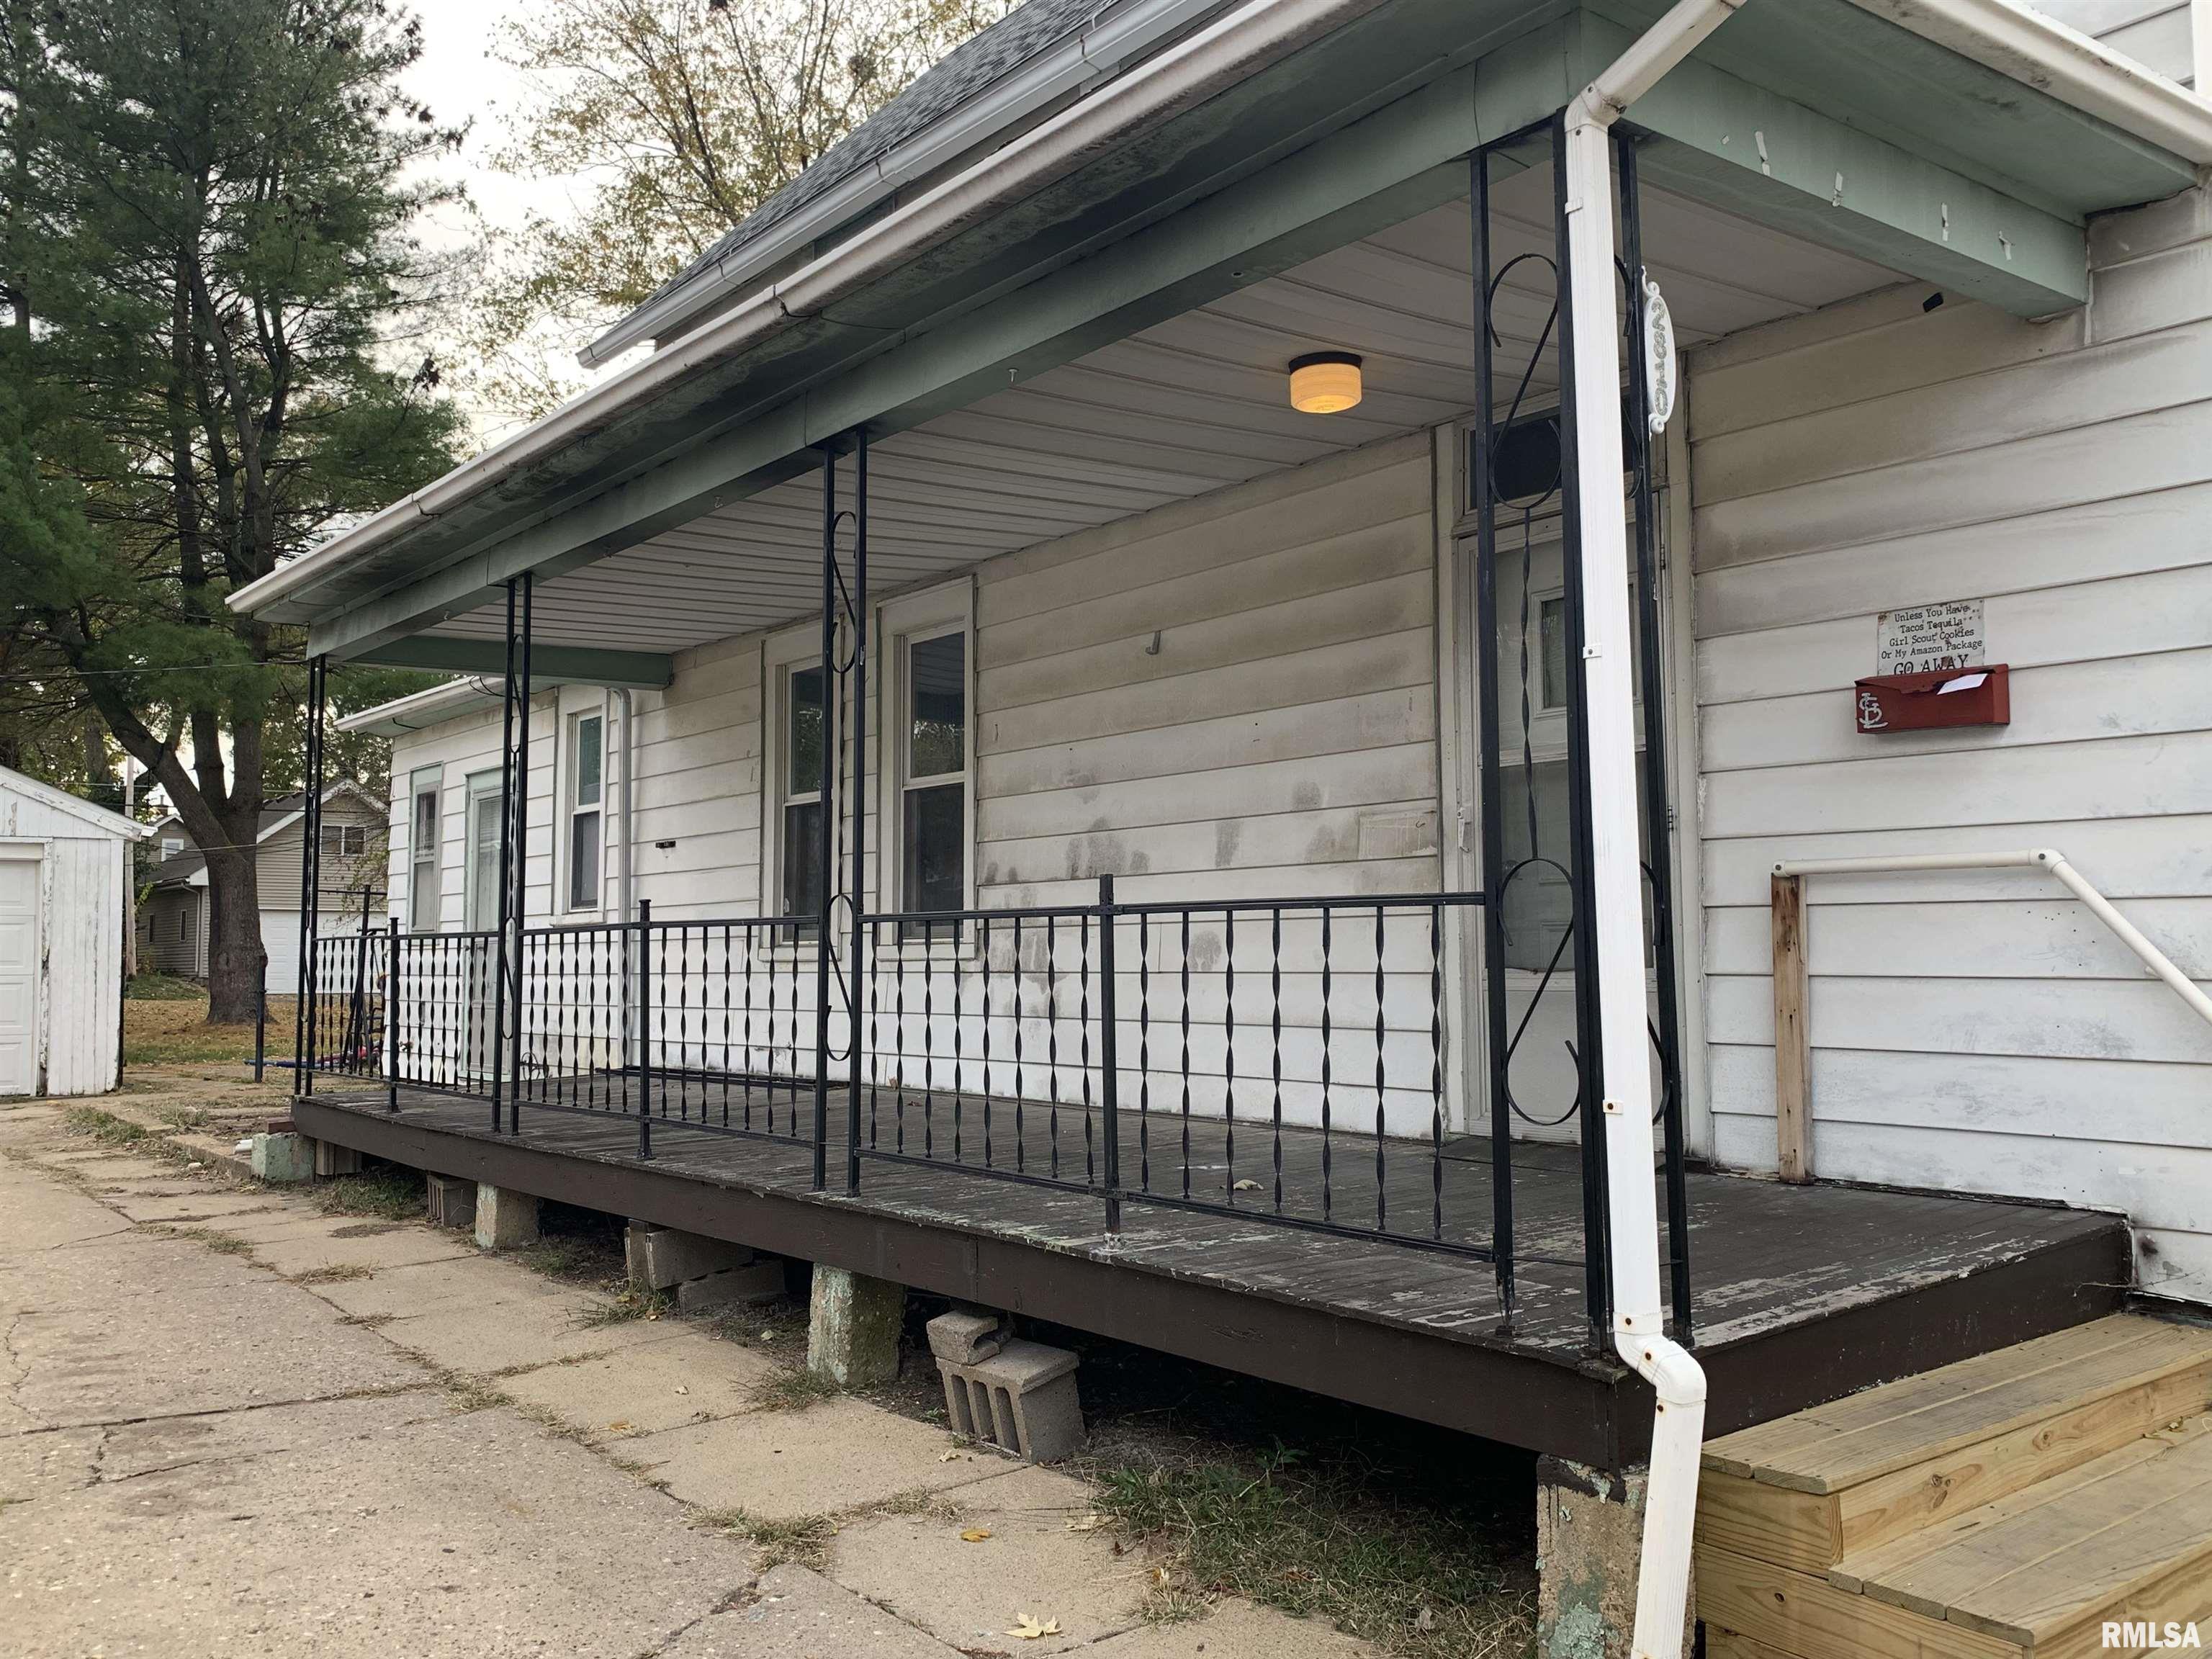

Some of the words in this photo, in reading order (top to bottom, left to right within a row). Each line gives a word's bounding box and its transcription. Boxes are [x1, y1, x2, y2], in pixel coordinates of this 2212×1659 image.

[1894, 611, 1923, 622] Unless
[1926, 608, 1942, 618] You
[1899, 624, 1924, 634] Tacos
[1927, 617, 1963, 631] Tequila
[1889, 636, 1908, 647] Girl
[1912, 634, 1936, 644] Scout
[1940, 629, 1974, 640] Cookies
[1881, 651, 1892, 660] Or
[1895, 649, 1907, 659] My
[1910, 647, 1943, 656] Amazon
[1946, 640, 1982, 650] Package
[1894, 661, 1914, 675] GO
[1921, 654, 1969, 673] AWAY
